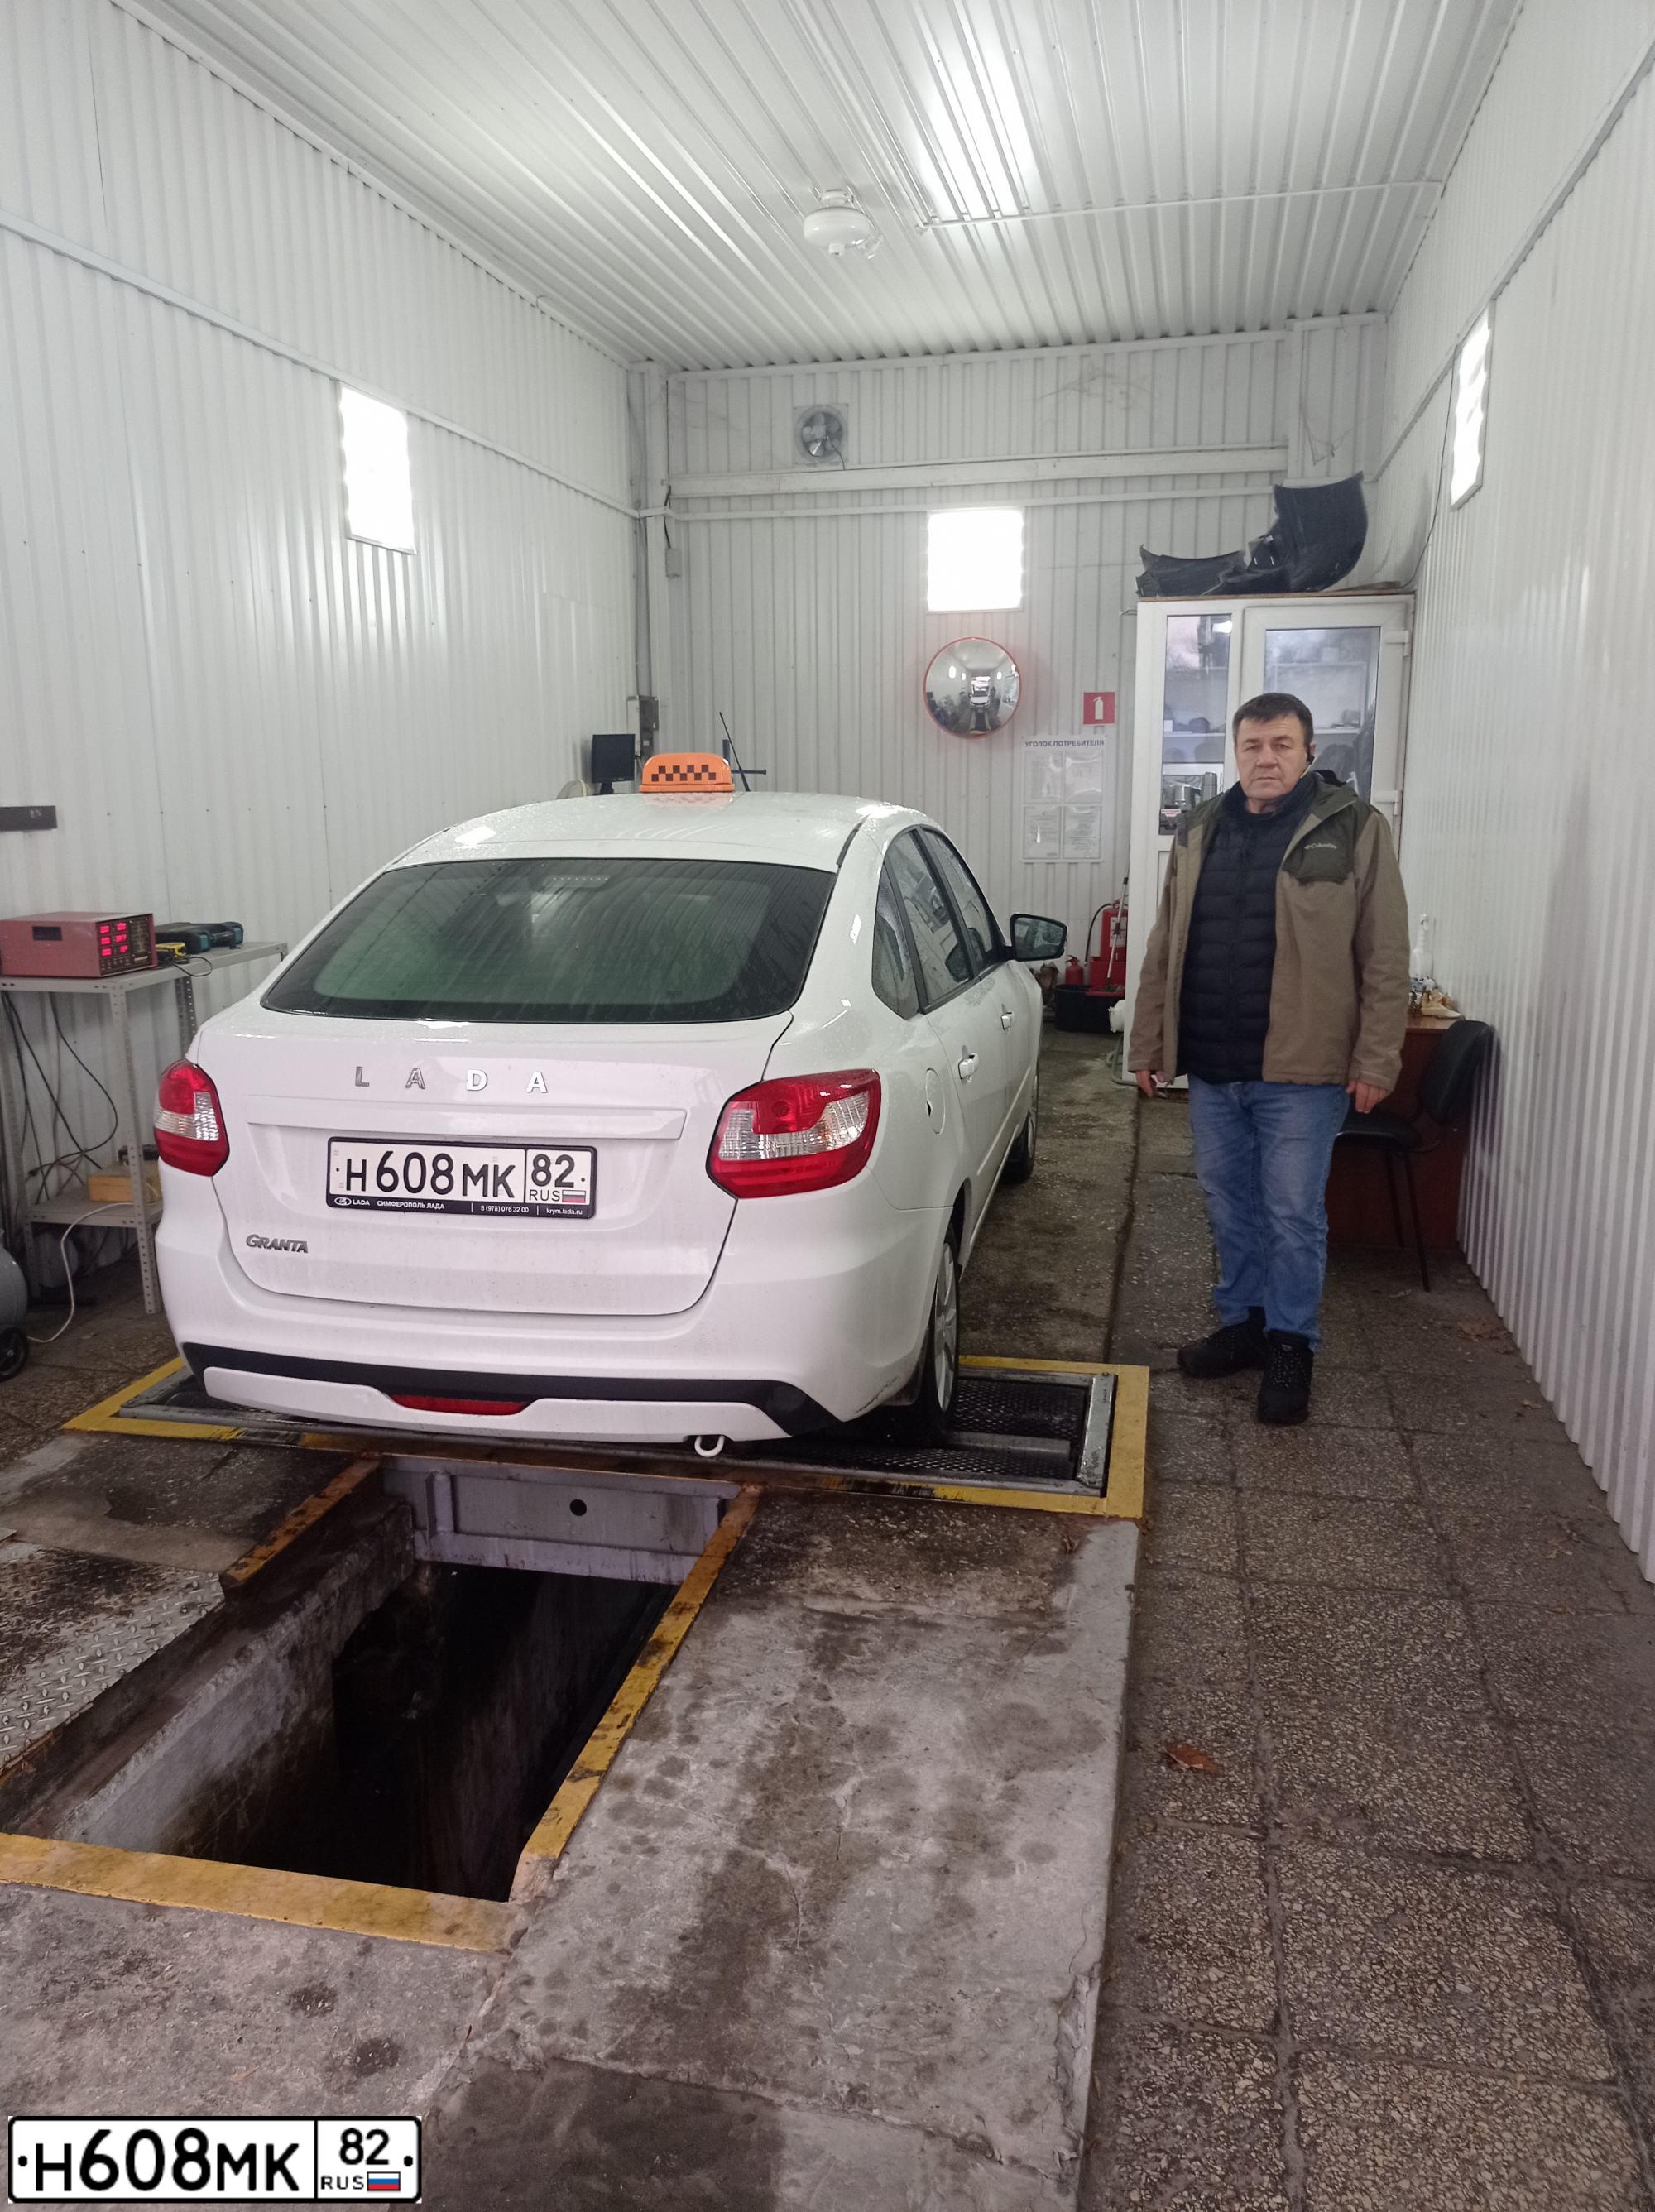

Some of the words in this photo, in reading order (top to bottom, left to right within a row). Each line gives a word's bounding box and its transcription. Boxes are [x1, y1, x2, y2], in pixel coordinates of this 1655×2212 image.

[354, 1065, 548, 1093] LADA
[530, 1154, 574, 1188] 82
[528, 1189, 561, 1202] RUS
[377, 1200, 426, 1208] СИМФЕРОПОЛЬ
[546, 1207, 583, 1216] krym.lada.ru
[246, 1234, 309, 1254] GRANTA
